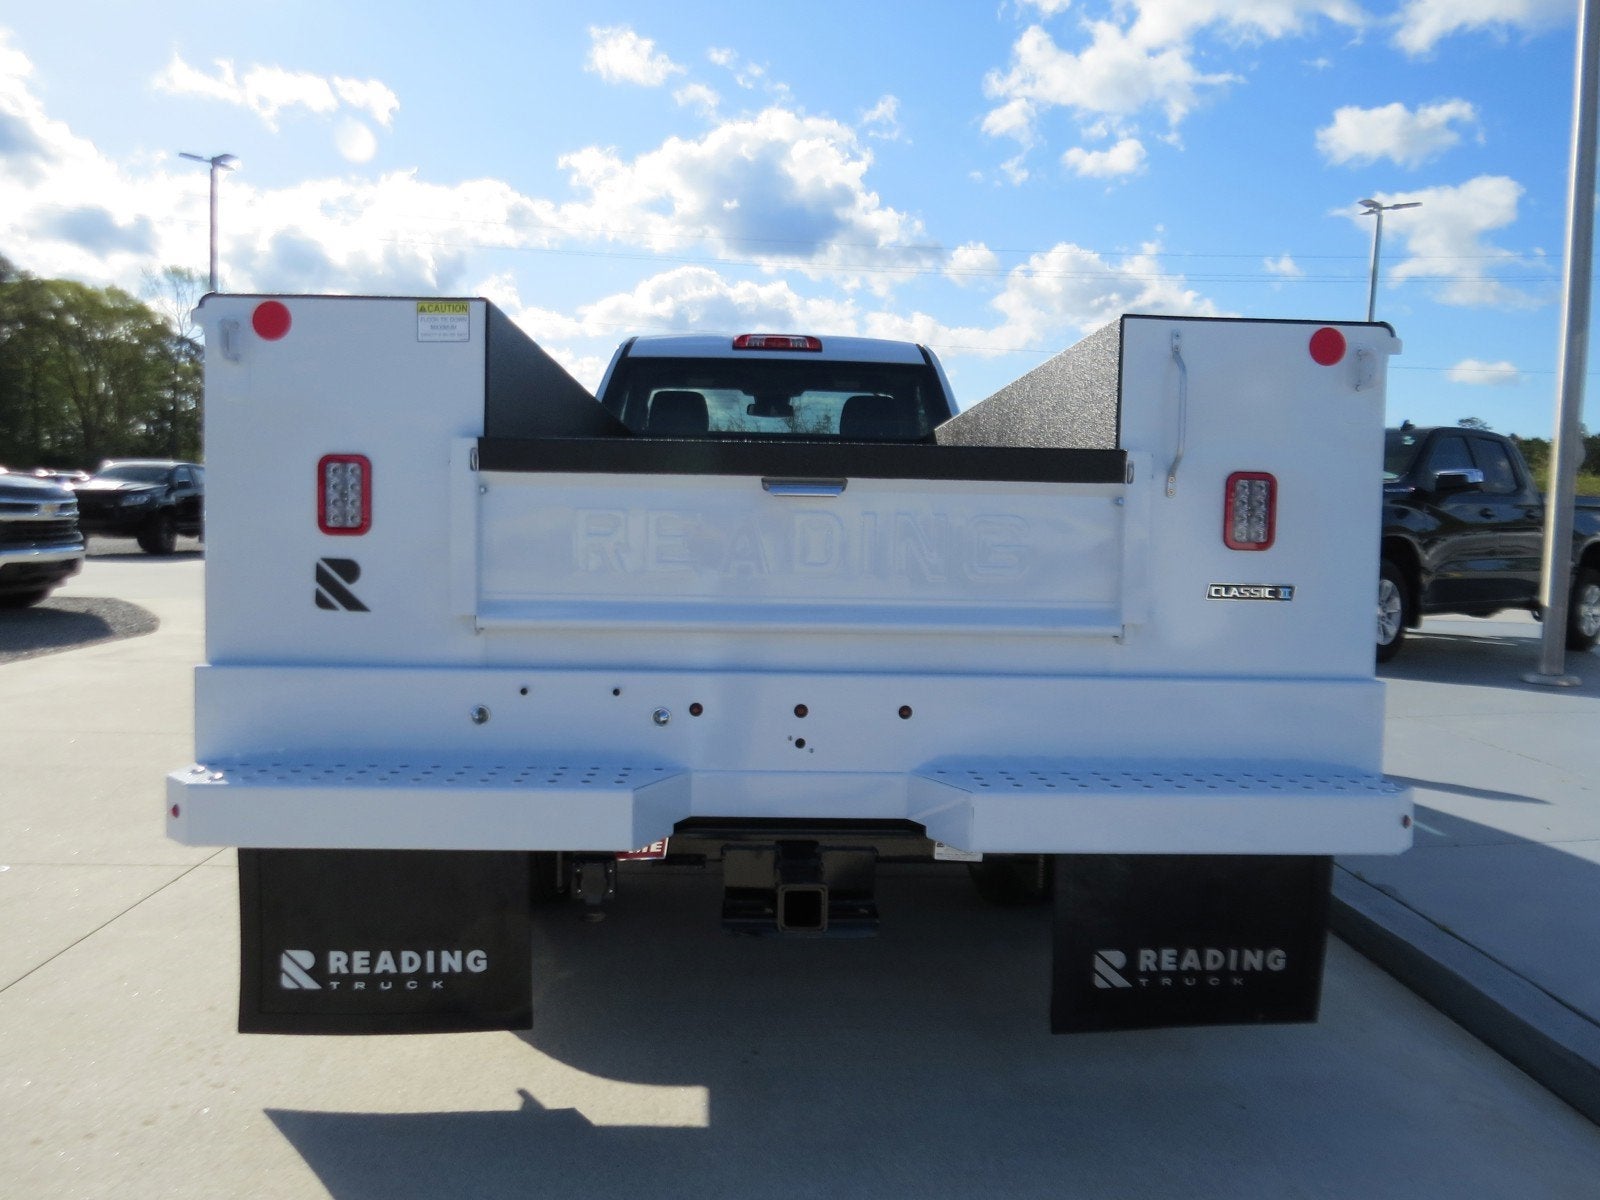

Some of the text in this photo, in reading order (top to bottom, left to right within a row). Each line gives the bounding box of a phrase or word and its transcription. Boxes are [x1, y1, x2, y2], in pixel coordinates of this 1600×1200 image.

[427, 304, 468, 313] CAUTION
[573, 507, 1030, 584] READING
[1211, 586, 1275, 598] CLASSIC
[329, 950, 488, 974] READING
[1139, 949, 1287, 971] READING
[330, 981, 444, 990] TRUCK
[1139, 978, 1244, 987] TRUCK
